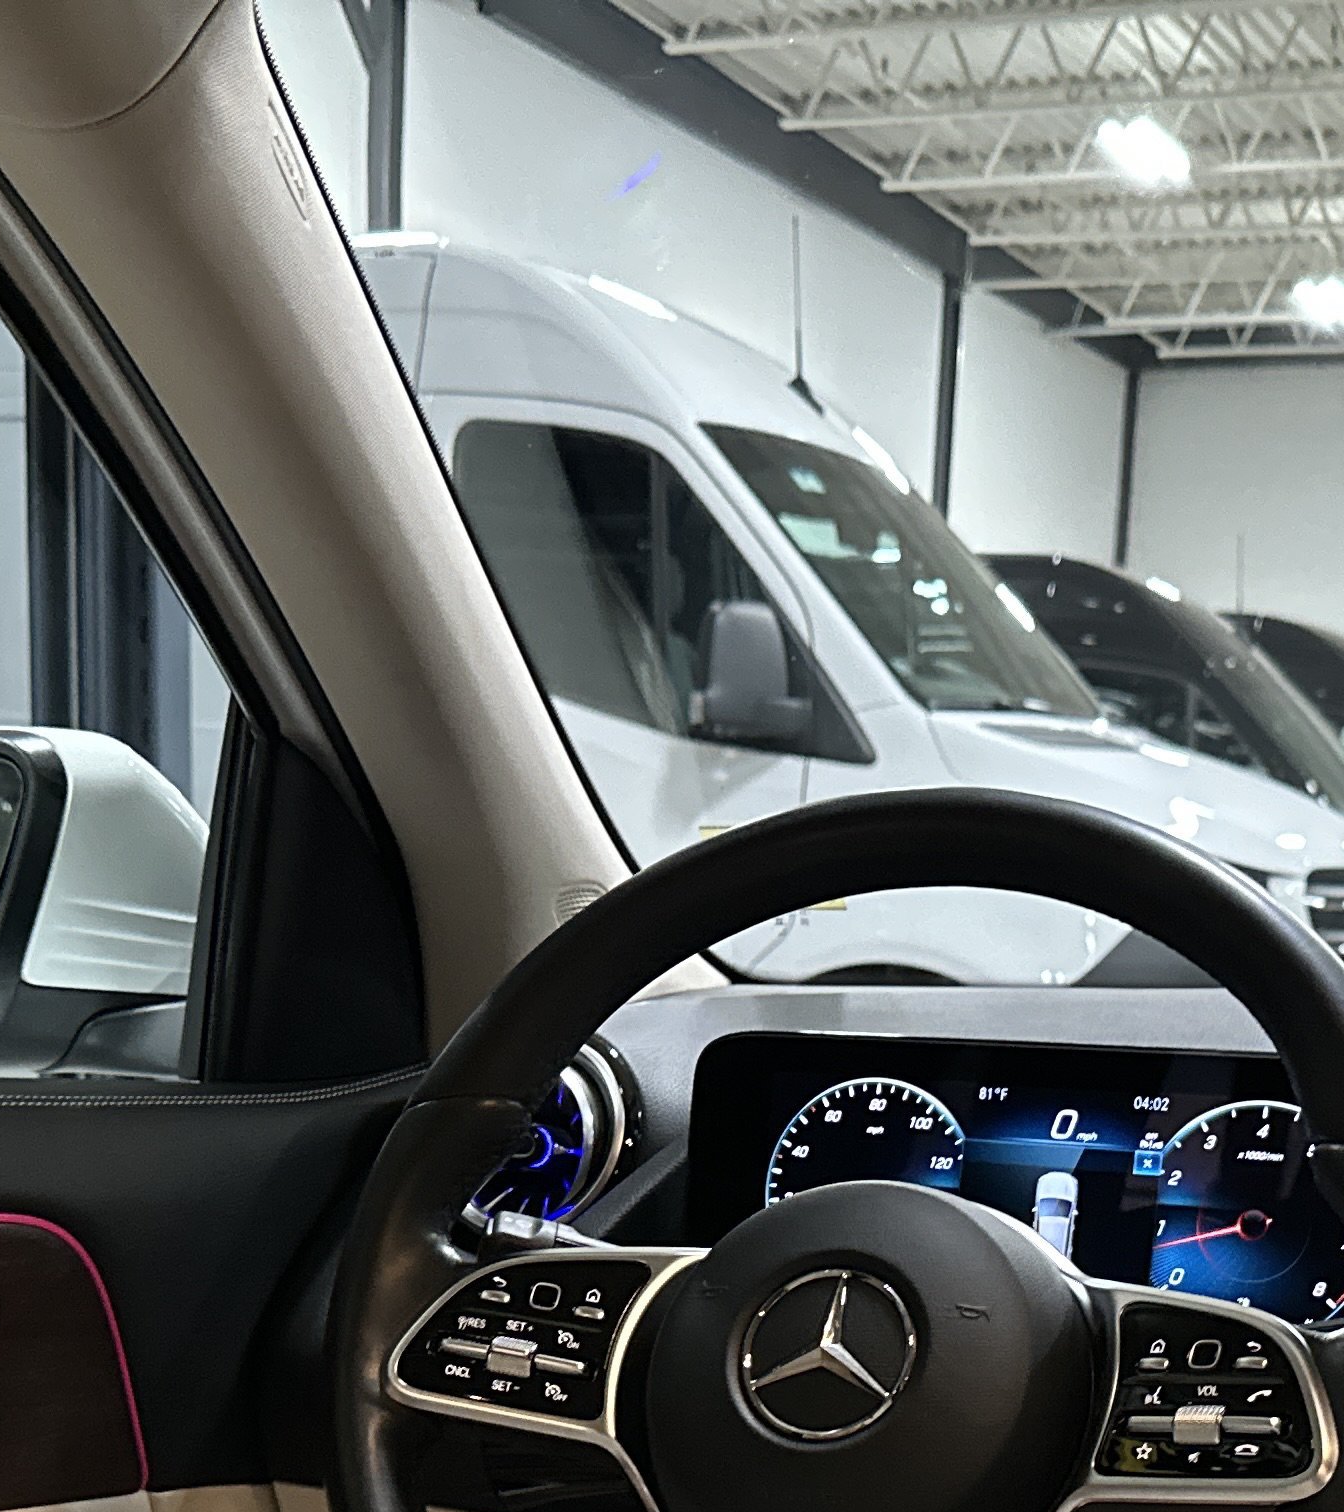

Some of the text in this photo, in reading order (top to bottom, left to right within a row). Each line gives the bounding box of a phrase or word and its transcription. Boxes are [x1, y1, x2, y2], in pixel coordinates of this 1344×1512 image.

[978, 1086, 1009, 1101] 81°F
[1133, 1095, 1170, 1112] 04:02
[909, 1116, 934, 1130] 100
[1050, 1108, 1079, 1140] 0
[1256, 1124, 1270, 1139] 4
[1203, 1135, 1217, 1150] 3
[791, 1146, 810, 1158] 40
[929, 1156, 953, 1170] 120
[1167, 1170, 1182, 1186] 2
[1156, 1219, 1167, 1237] 1
[1168, 1267, 1185, 1285] 0
[1312, 1281, 1327, 1297] 8
[1197, 1385, 1219, 1397] VOL
